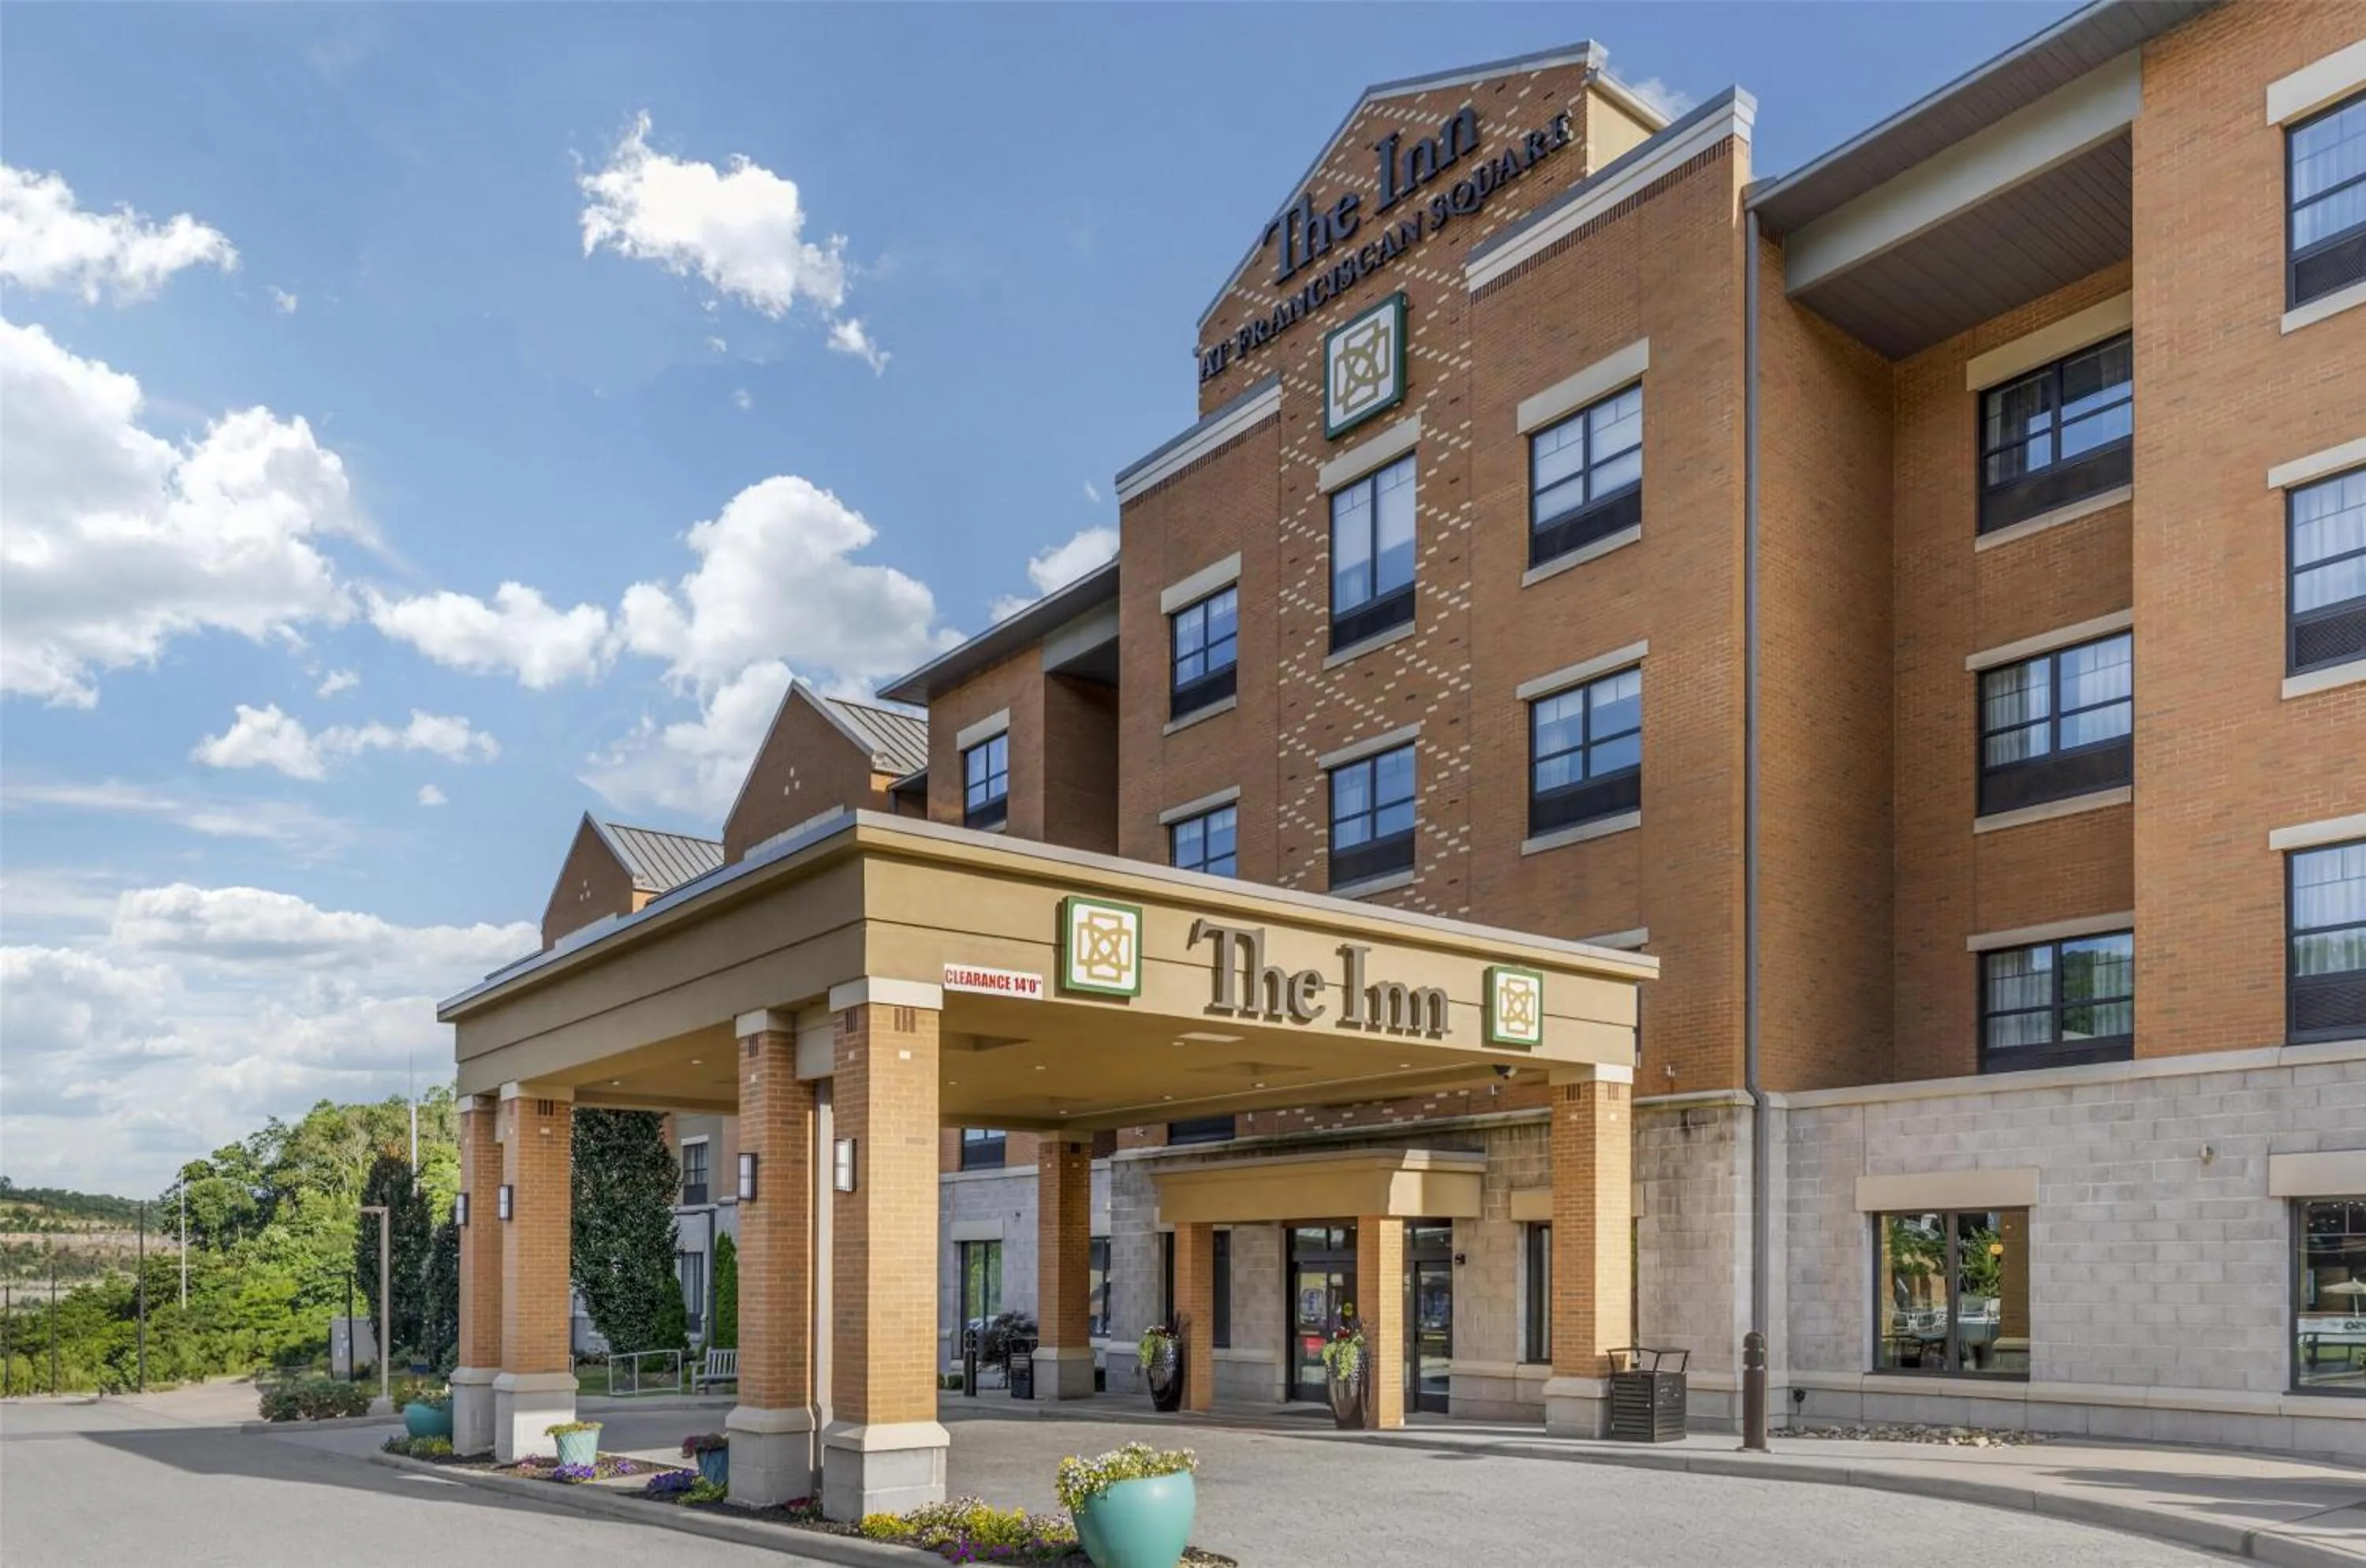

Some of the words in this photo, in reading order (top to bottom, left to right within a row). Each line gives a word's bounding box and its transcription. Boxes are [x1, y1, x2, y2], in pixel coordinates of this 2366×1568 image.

[1199, 338, 1230, 380] AT
[1235, 211, 1423, 360] FRANCISCAN
[1430, 110, 1573, 231] SQUARE
[1263, 191, 1361, 286] The
[1373, 106, 1480, 216] Inn
[946, 969, 1012, 991] CLEARANCE
[1188, 918, 1327, 1023] The
[1338, 943, 1453, 1038] Inn
